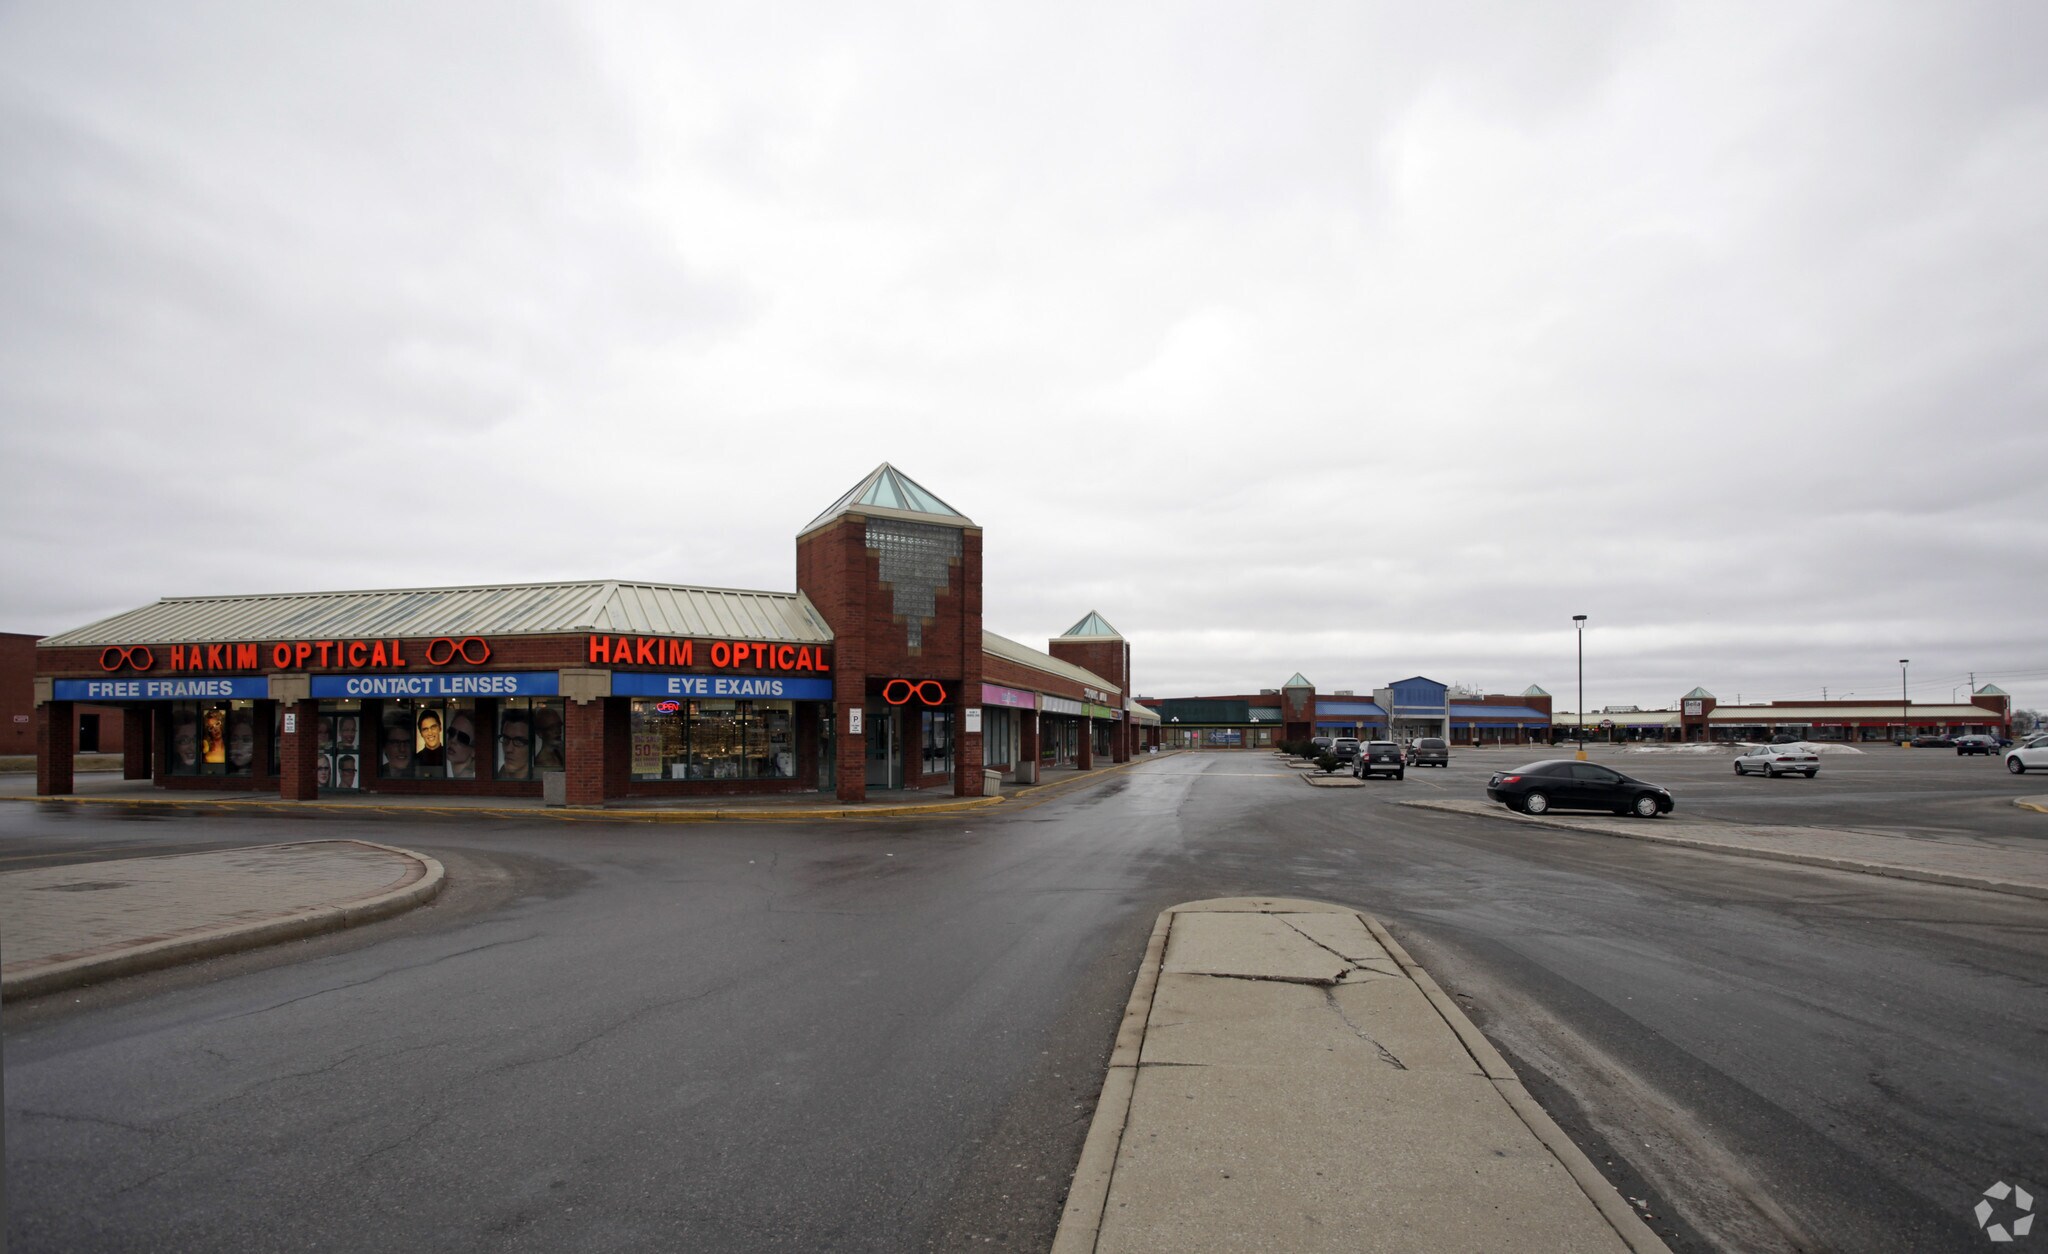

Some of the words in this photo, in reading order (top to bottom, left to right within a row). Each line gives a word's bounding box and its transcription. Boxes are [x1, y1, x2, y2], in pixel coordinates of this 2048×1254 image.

[171, 644, 257, 669] HAKIM
[273, 639, 405, 668] OPTICAL
[589, 636, 693, 666] HAKIM
[711, 641, 829, 671] OPTICAL
[88, 682, 140, 697] FREE
[147, 681, 233, 696] FRAMES
[347, 678, 432, 694] CONTACT
[440, 677, 517, 693] LENSES
[668, 678, 707, 694] EYE
[716, 679, 783, 696] EXAMS
[656, 702, 679, 711] OPEN
